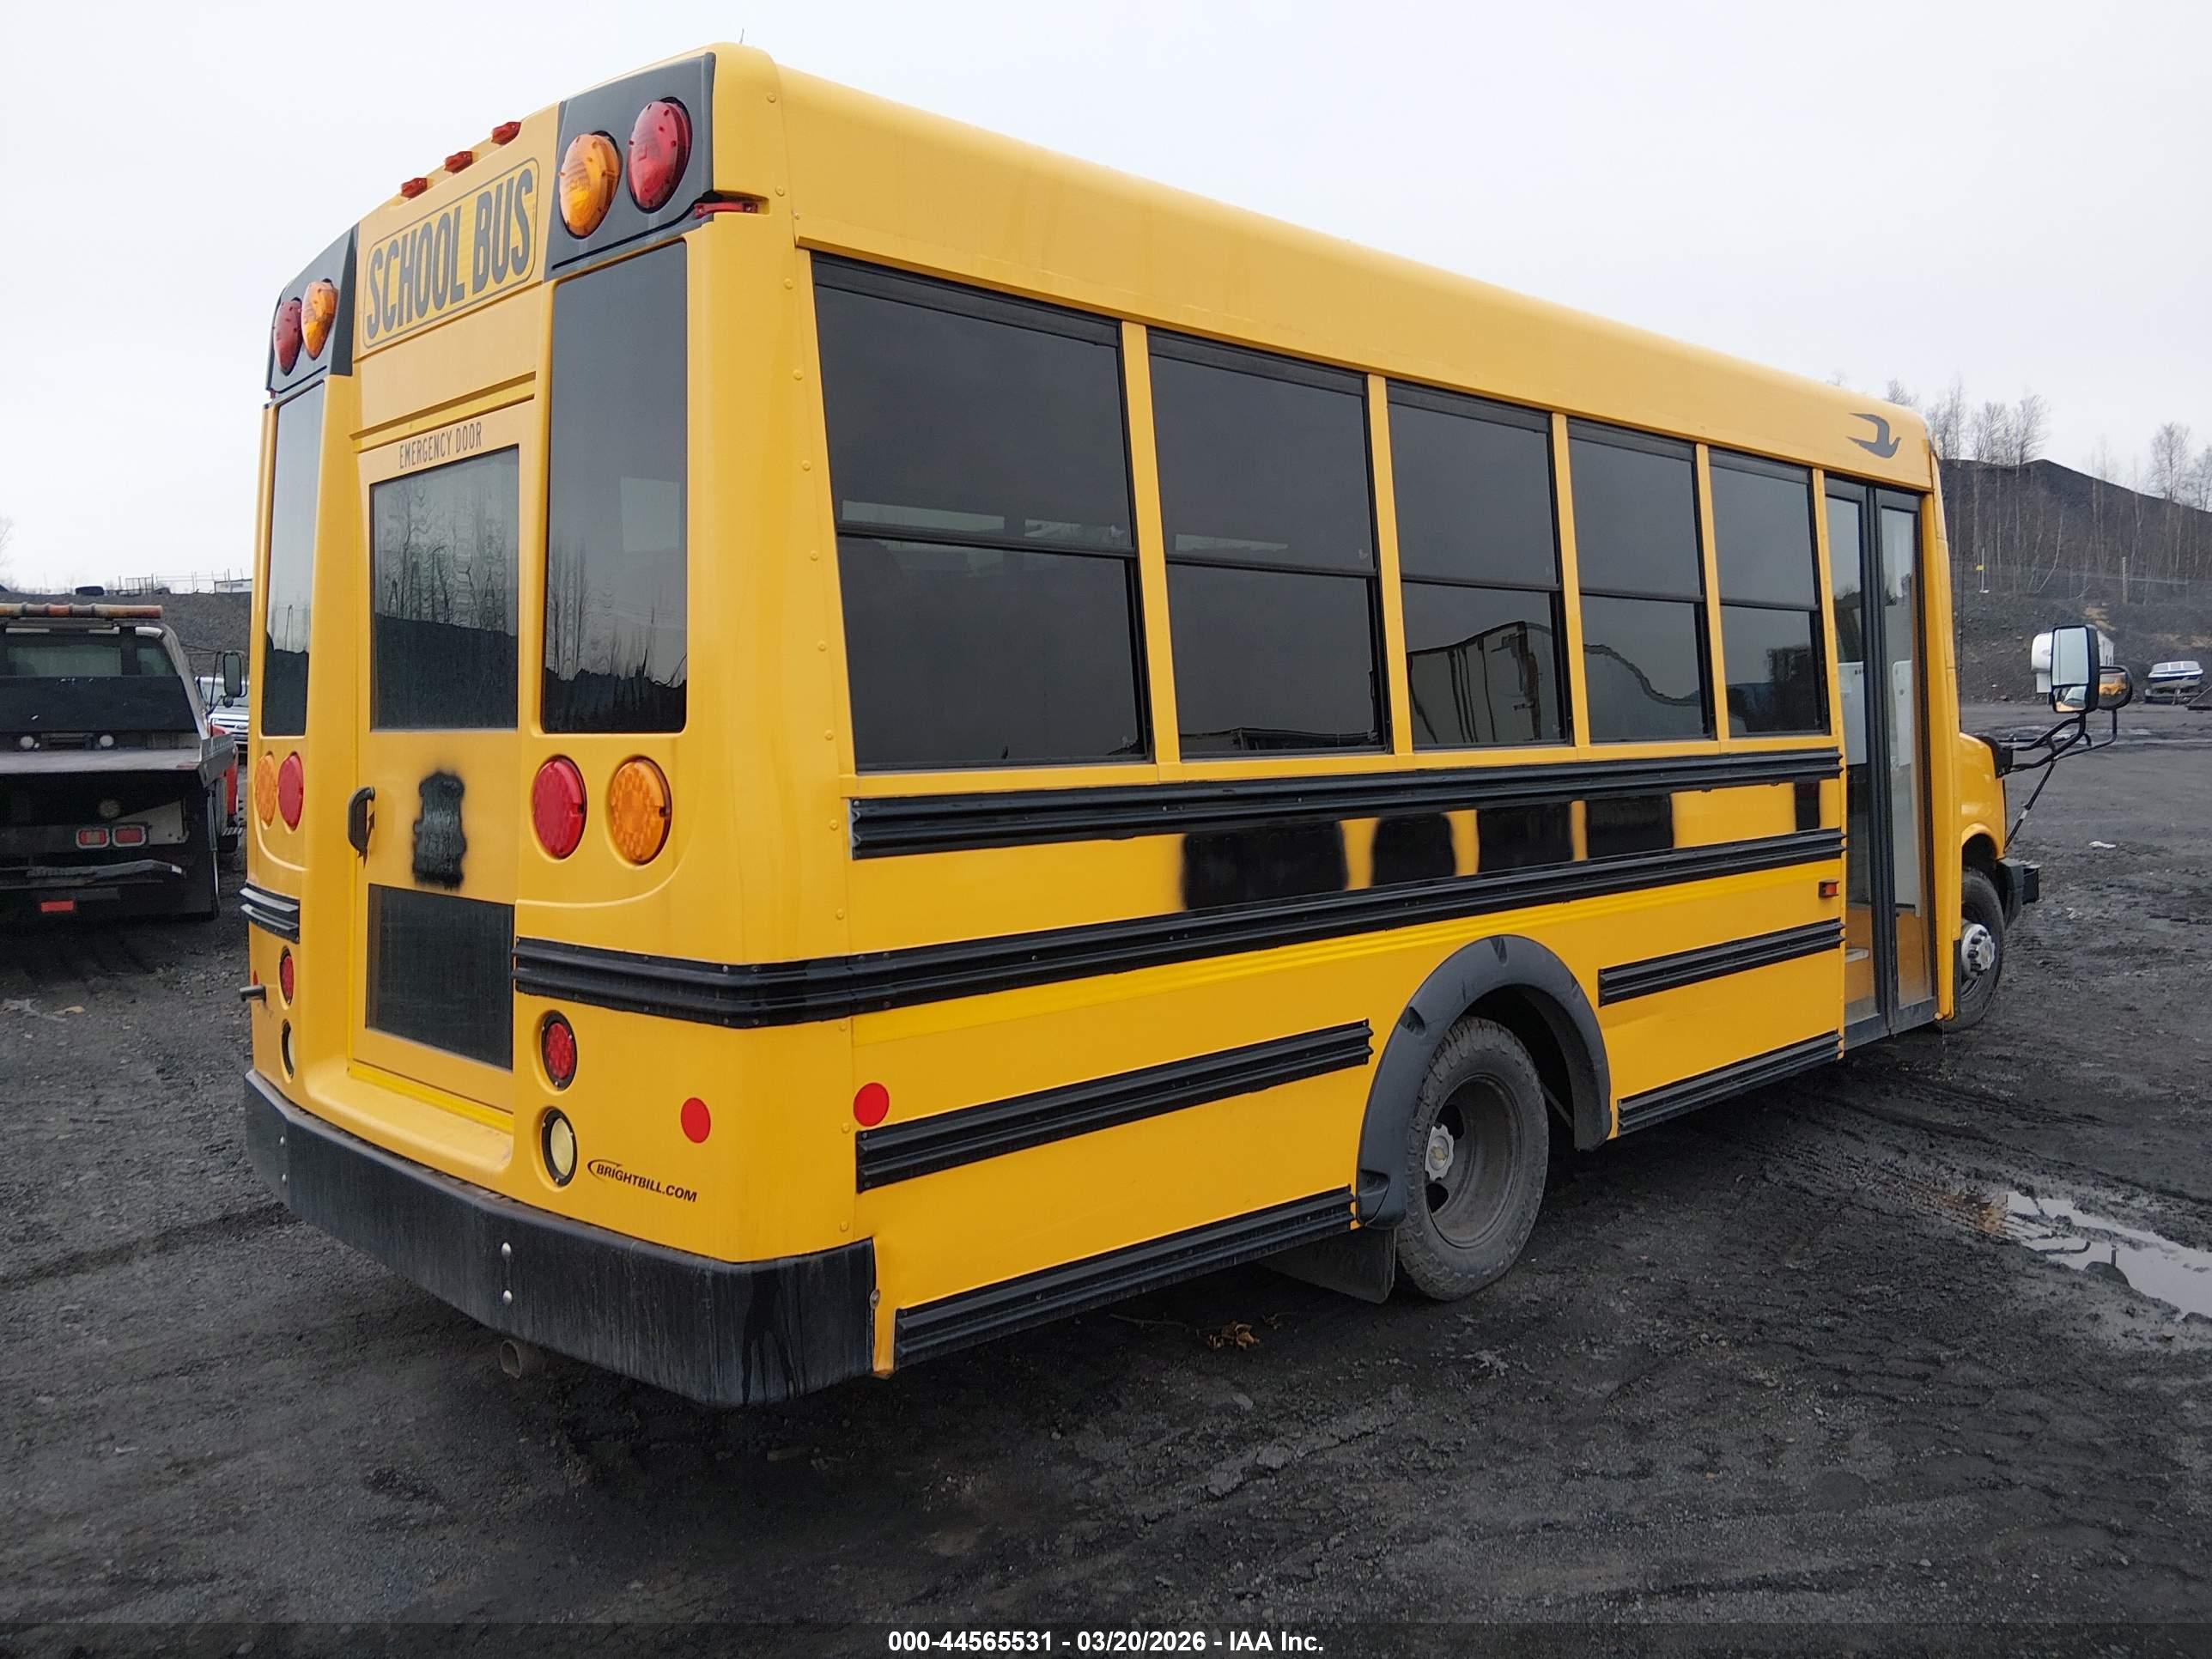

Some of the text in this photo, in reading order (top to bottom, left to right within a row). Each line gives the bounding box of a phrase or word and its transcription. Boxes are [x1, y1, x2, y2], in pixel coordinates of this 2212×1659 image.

[366, 168, 533, 340] SCHOOL BUS
[398, 421, 482, 470] EMERGENCY DOOR
[596, 1163, 698, 1203] BRIGHTBILL.COM
